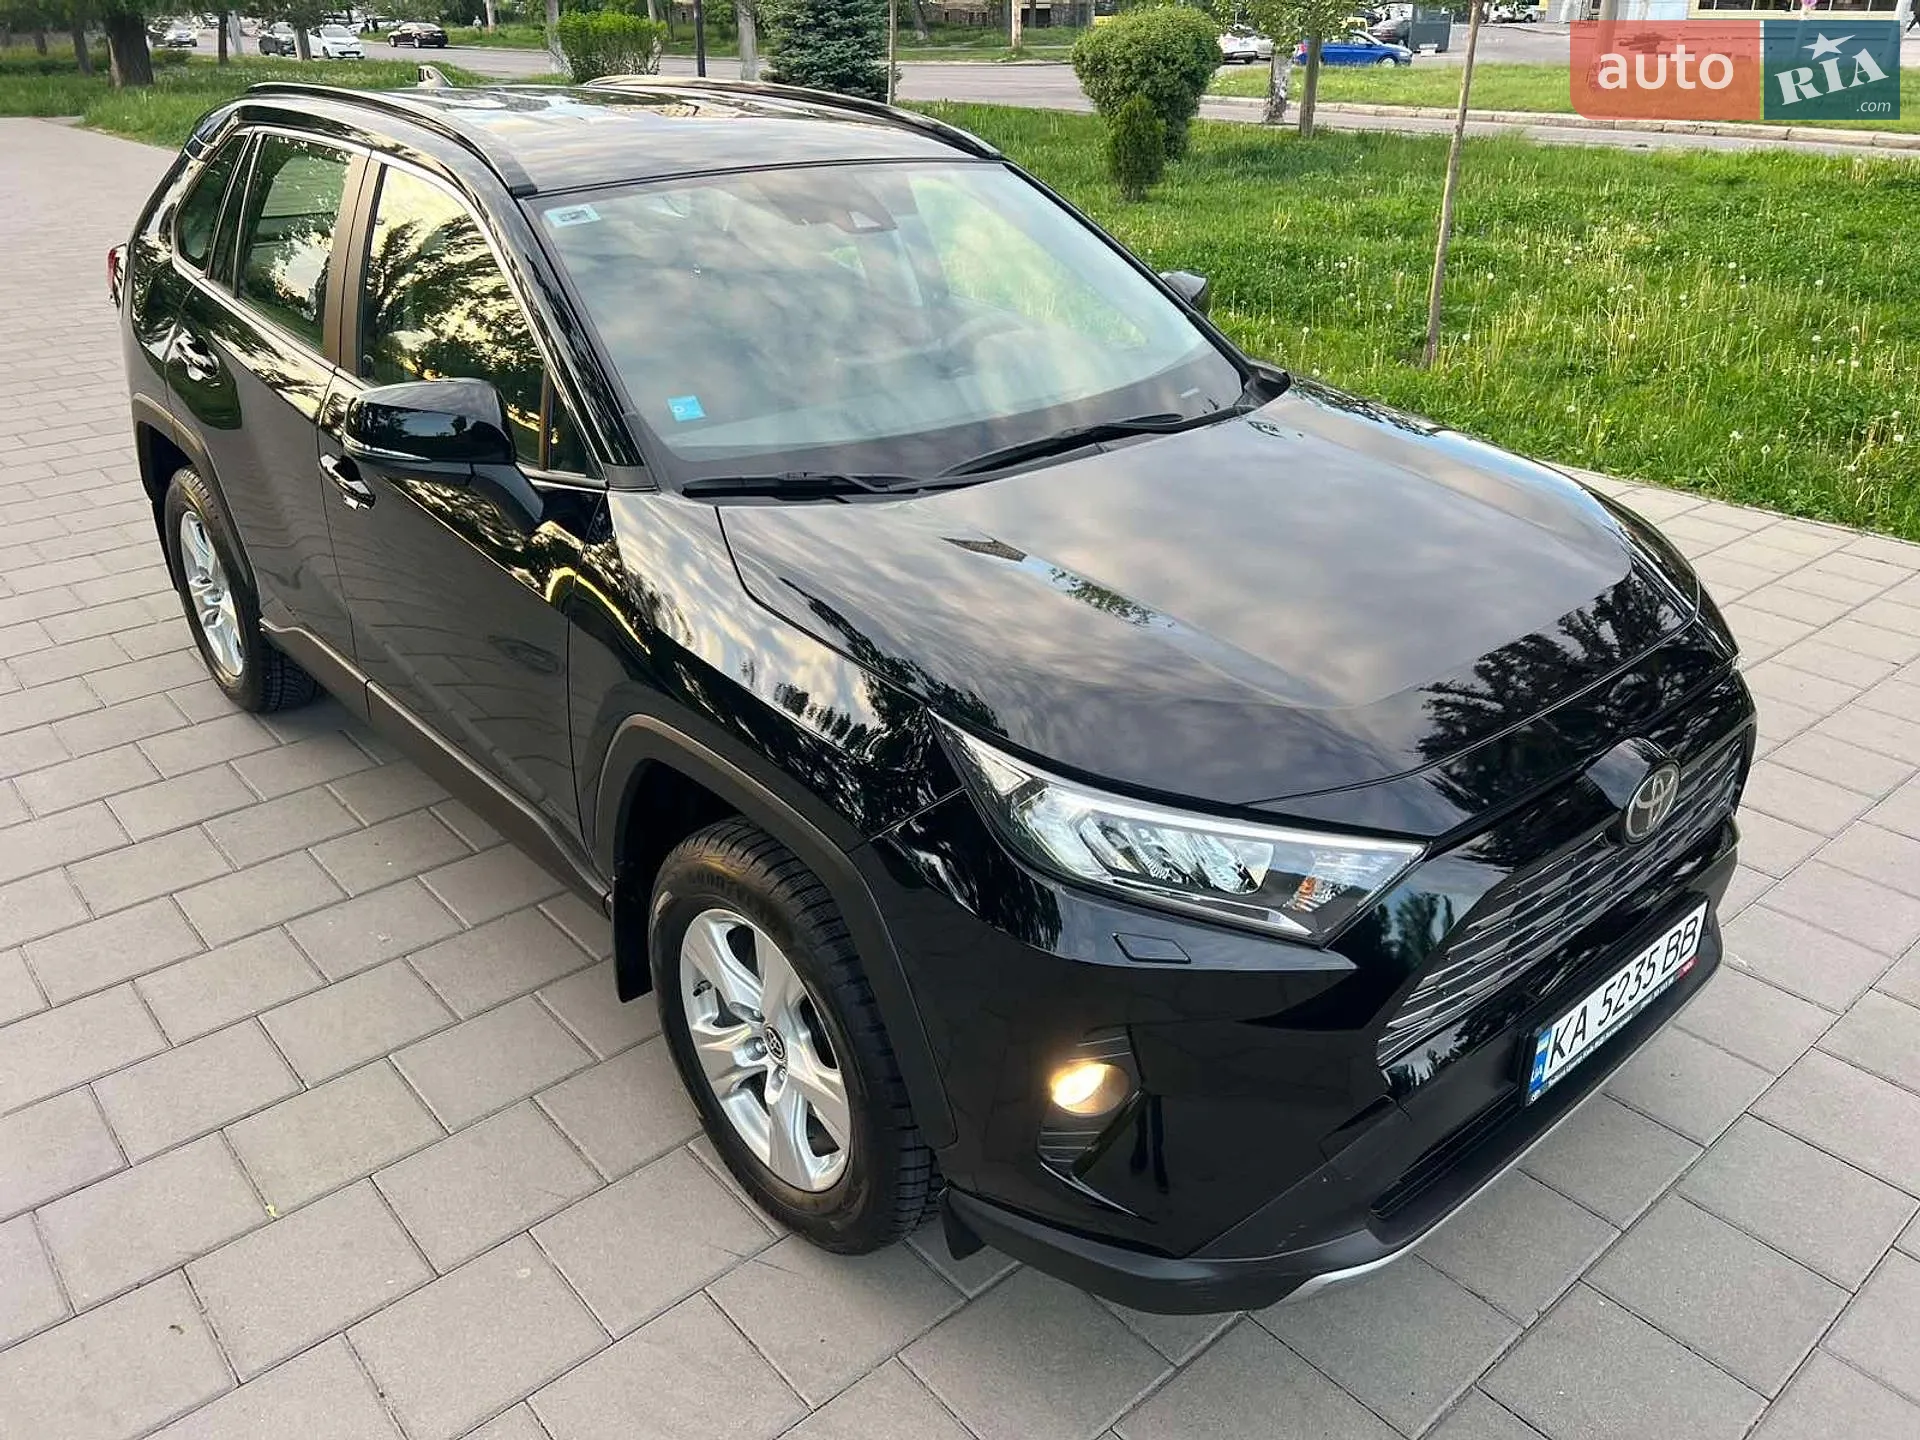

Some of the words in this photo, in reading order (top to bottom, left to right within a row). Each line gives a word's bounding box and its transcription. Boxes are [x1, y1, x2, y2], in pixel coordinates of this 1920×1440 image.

[1548, 1005, 1587, 1069] KA
[1598, 945, 1661, 1026] 5235
[1661, 915, 1698, 976] BB
